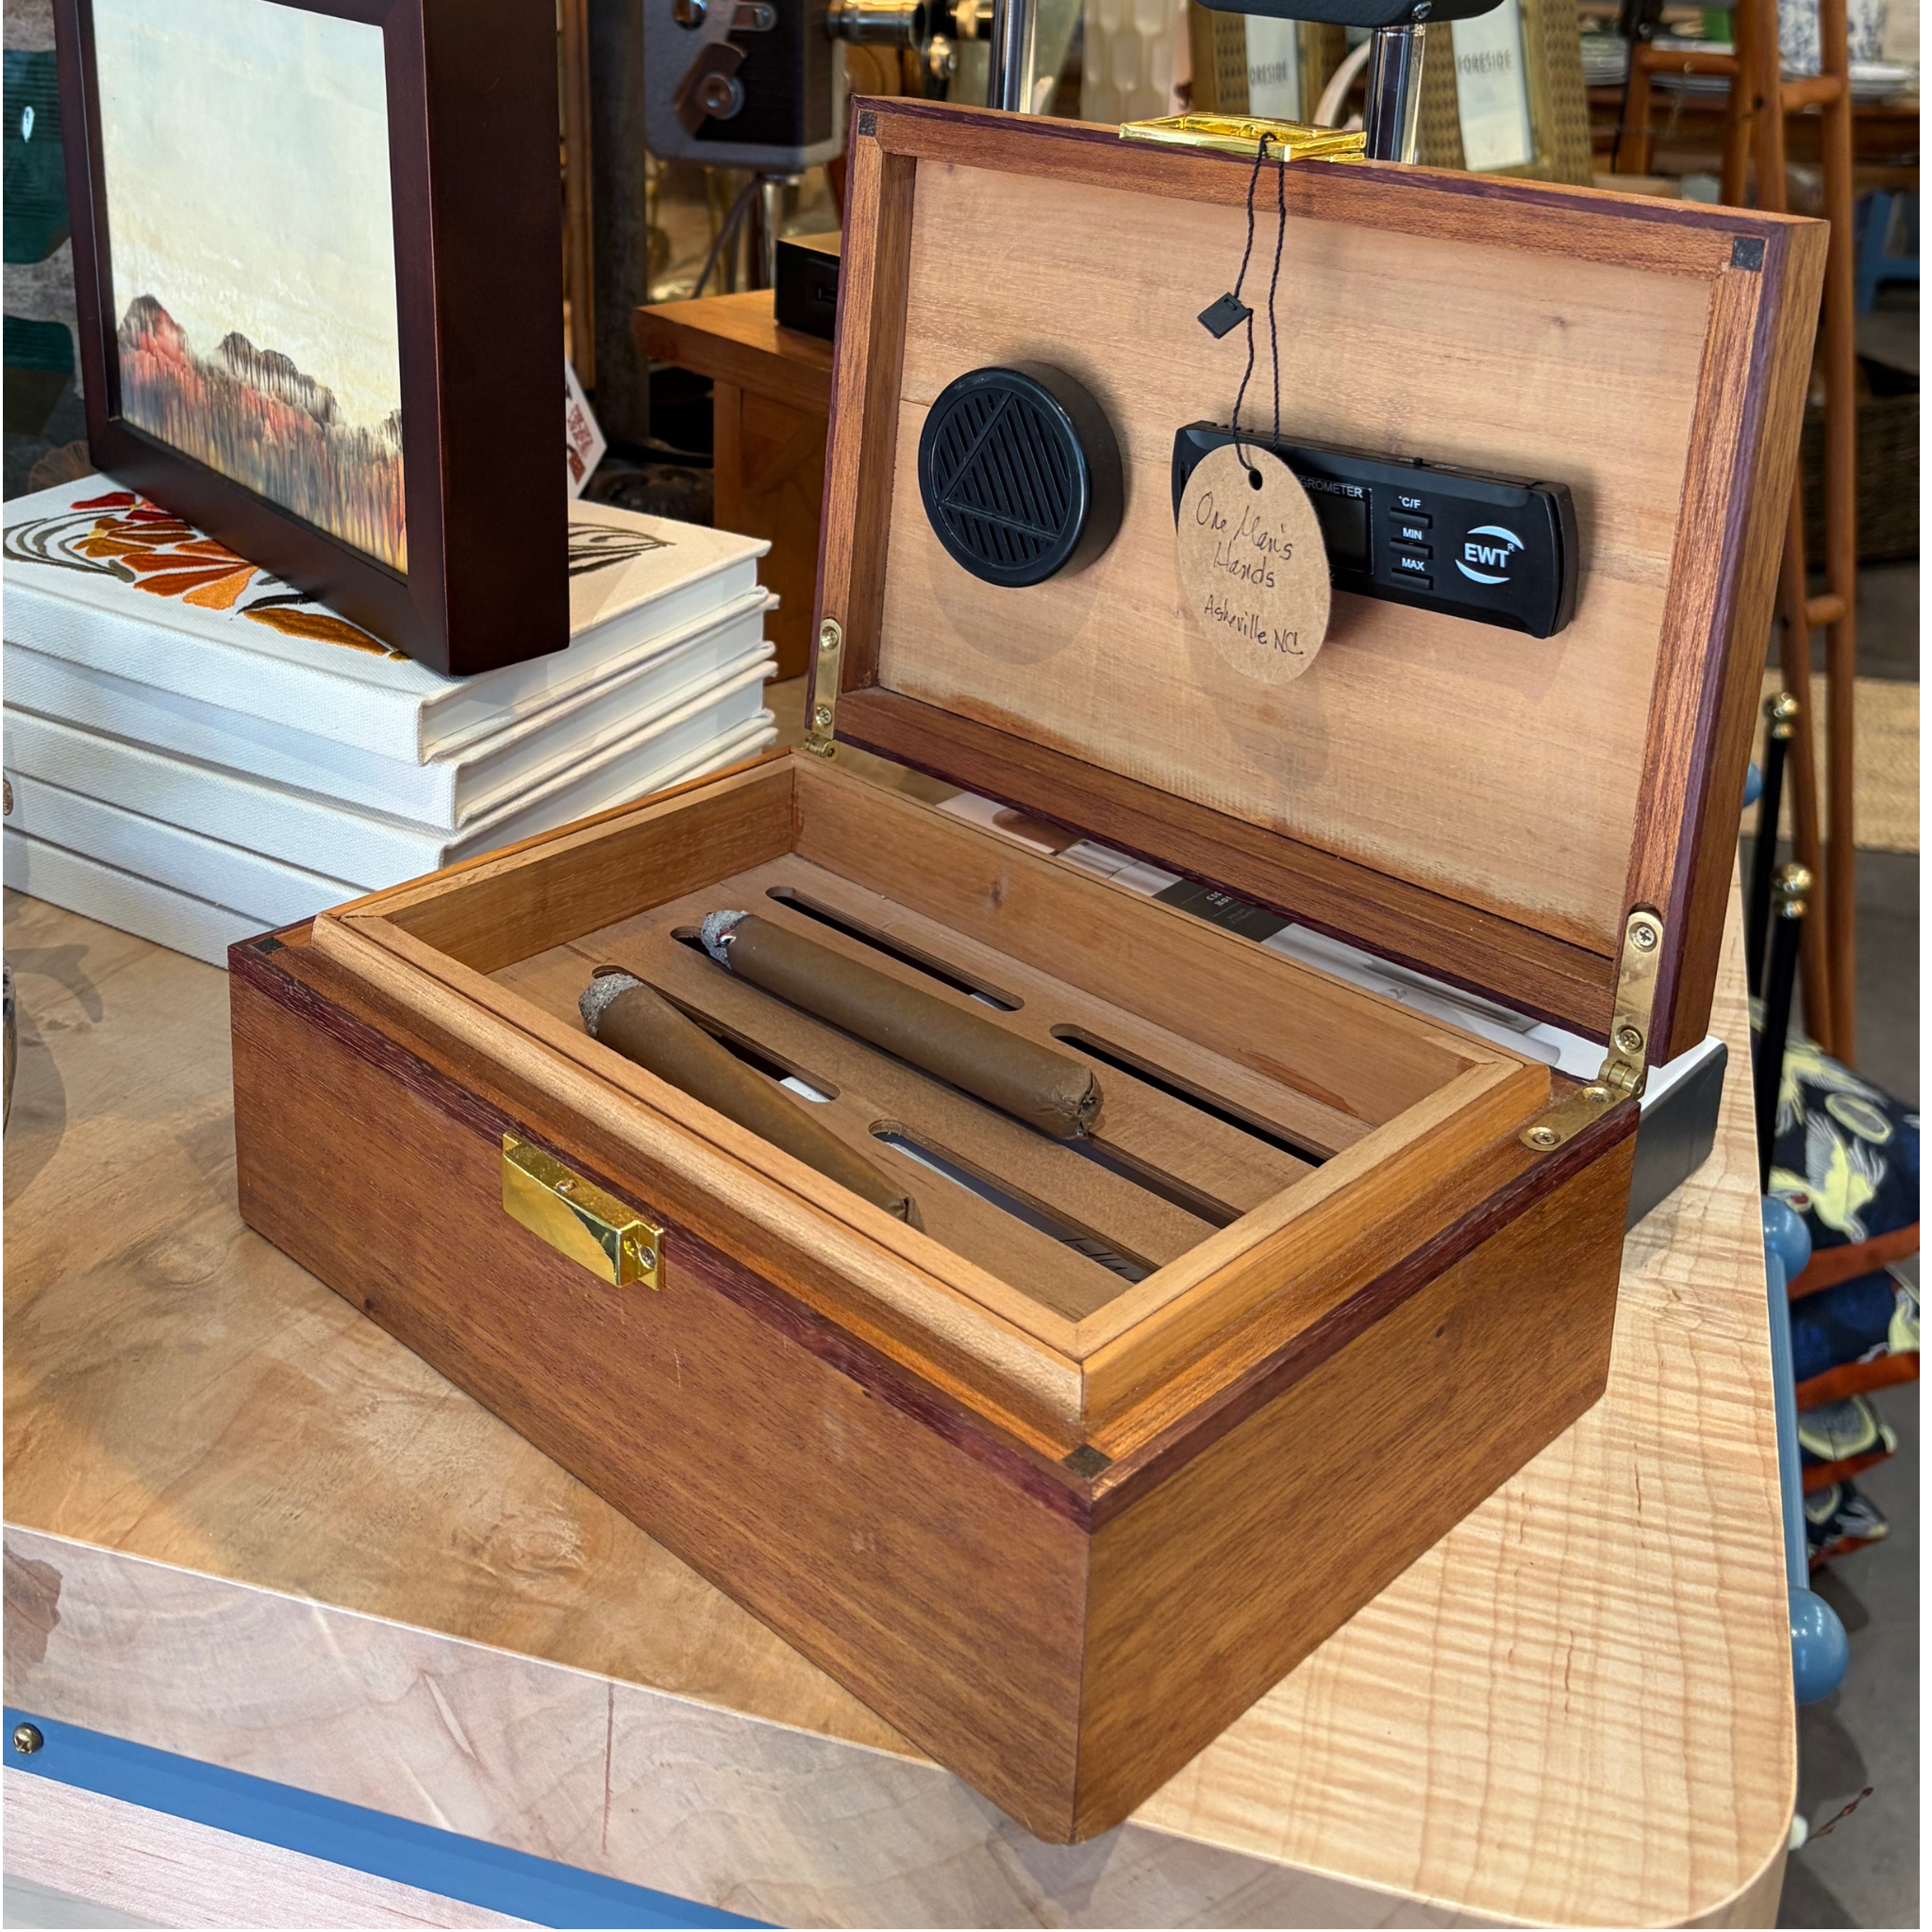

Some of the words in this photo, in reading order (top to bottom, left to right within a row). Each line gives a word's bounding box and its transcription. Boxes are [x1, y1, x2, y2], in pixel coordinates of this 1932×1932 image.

[1248, 61, 1287, 87] ORESIDE
[1299, 477, 1363, 499] GROMETER
[1195, 491, 1227, 533] One
[1402, 527, 1423, 541] MIN
[1213, 541, 1275, 589] Hands
[1402, 557, 1425, 572] MAX
[1464, 542, 1509, 568] EWT
[1204, 593, 1268, 645] Asheville
[1274, 628, 1304, 655] NC
